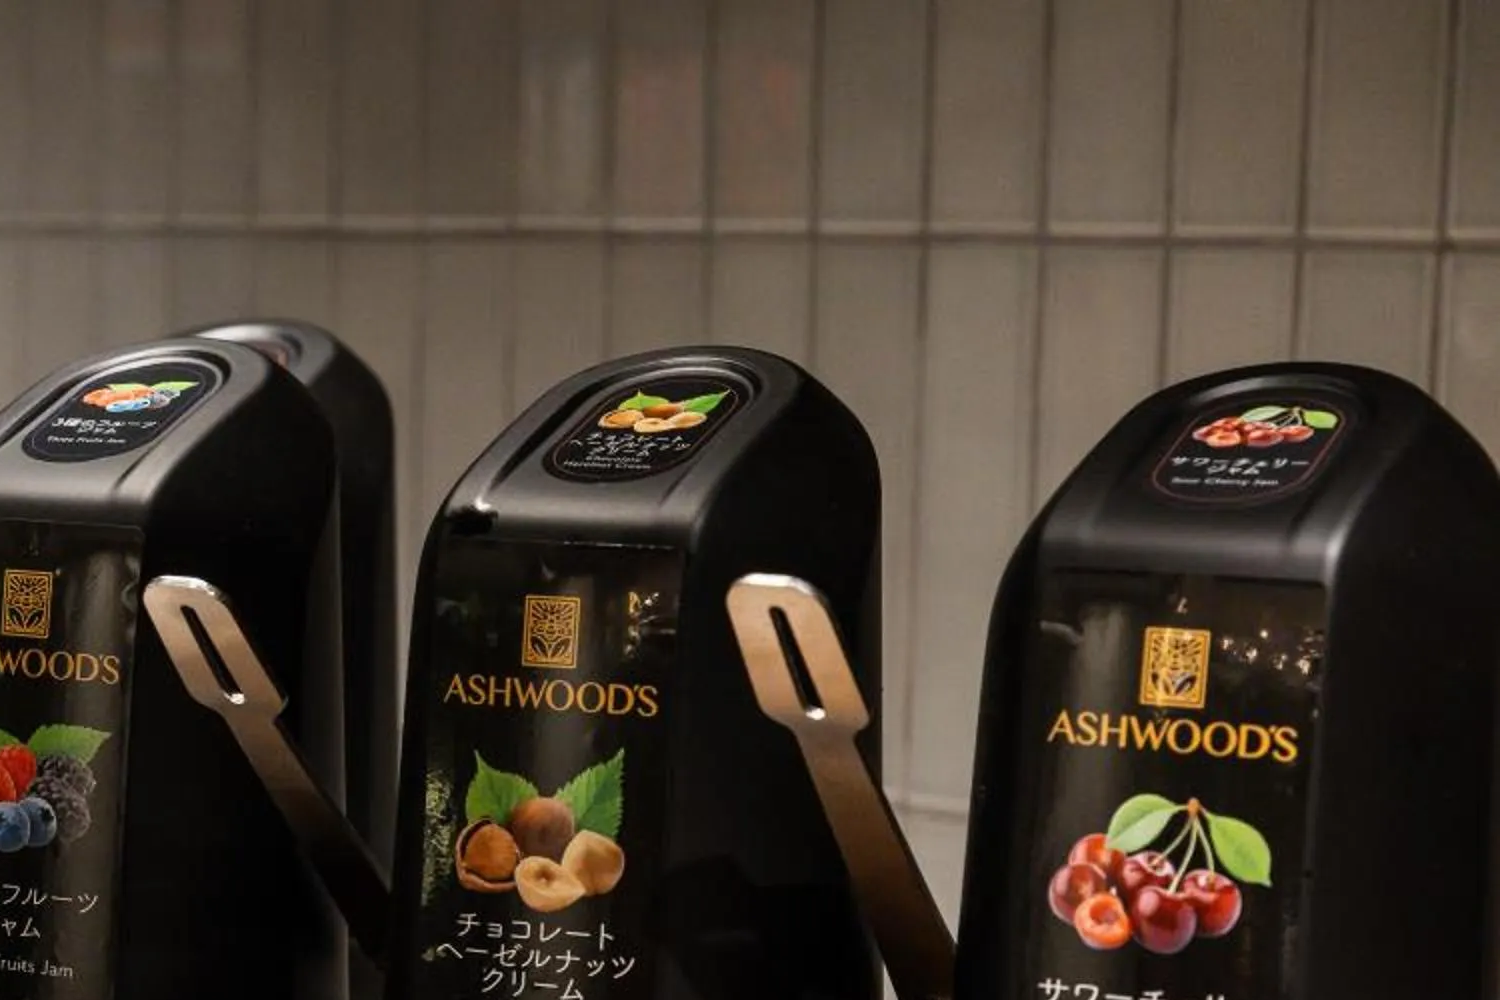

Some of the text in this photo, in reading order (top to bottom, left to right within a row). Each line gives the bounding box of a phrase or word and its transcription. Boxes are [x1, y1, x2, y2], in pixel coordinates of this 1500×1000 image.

[443, 673, 659, 717] ASHWOOD'S
[1047, 709, 1298, 763] ASHWOOD'S
[456, 912, 615, 950] チョコレート
[39, 959, 74, 979] Jam
[435, 943, 636, 979] ヘーゼルナッツ
